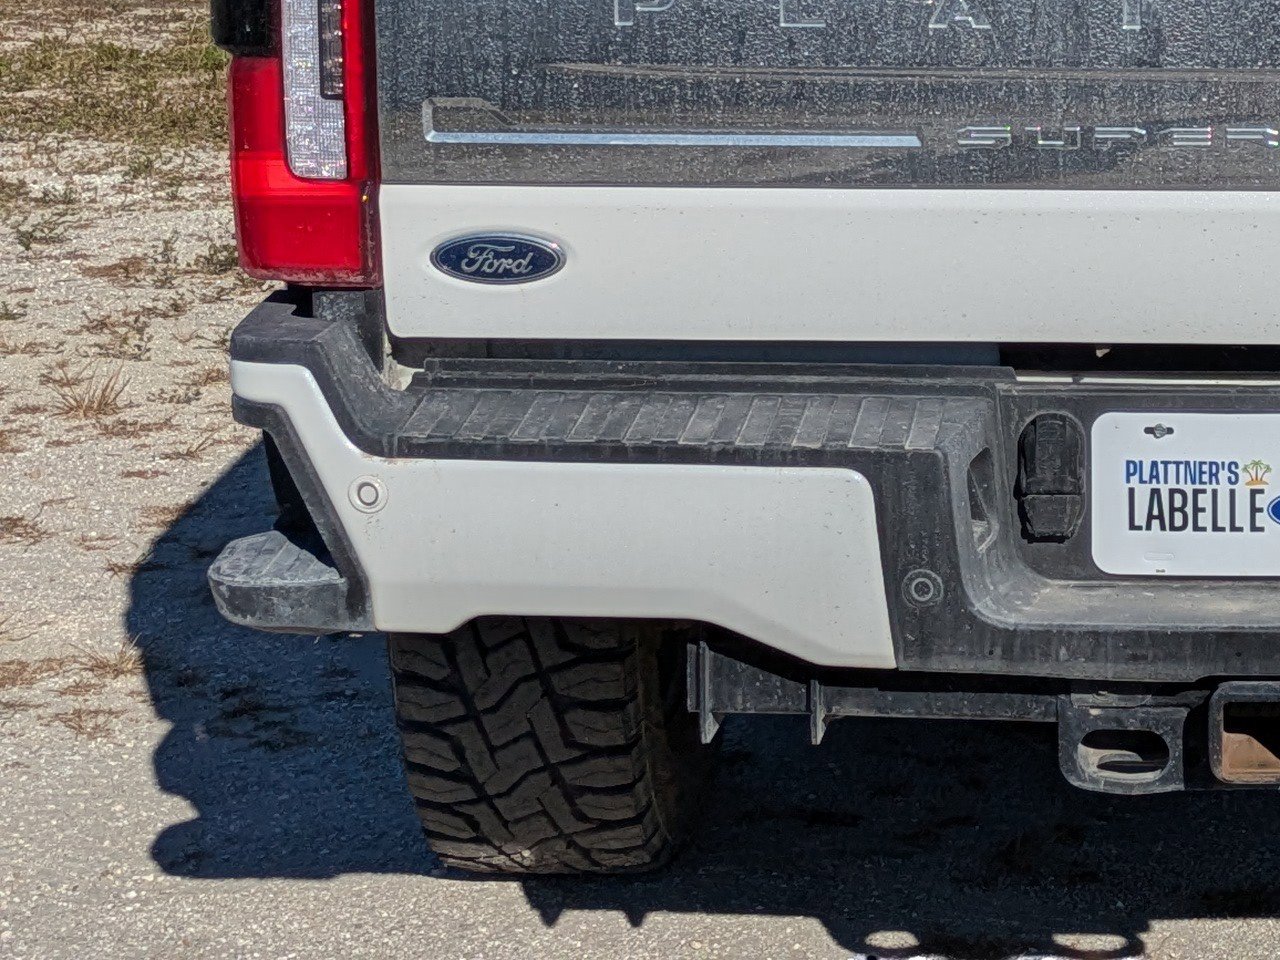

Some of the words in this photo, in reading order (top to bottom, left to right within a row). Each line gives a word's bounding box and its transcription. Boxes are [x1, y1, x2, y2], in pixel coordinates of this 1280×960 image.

[956, 125, 1279, 150] SUPER
[460, 243, 535, 275] Ford
[1125, 459, 1240, 486] PLATTNER'S
[1127, 487, 1267, 533] LABELLE
